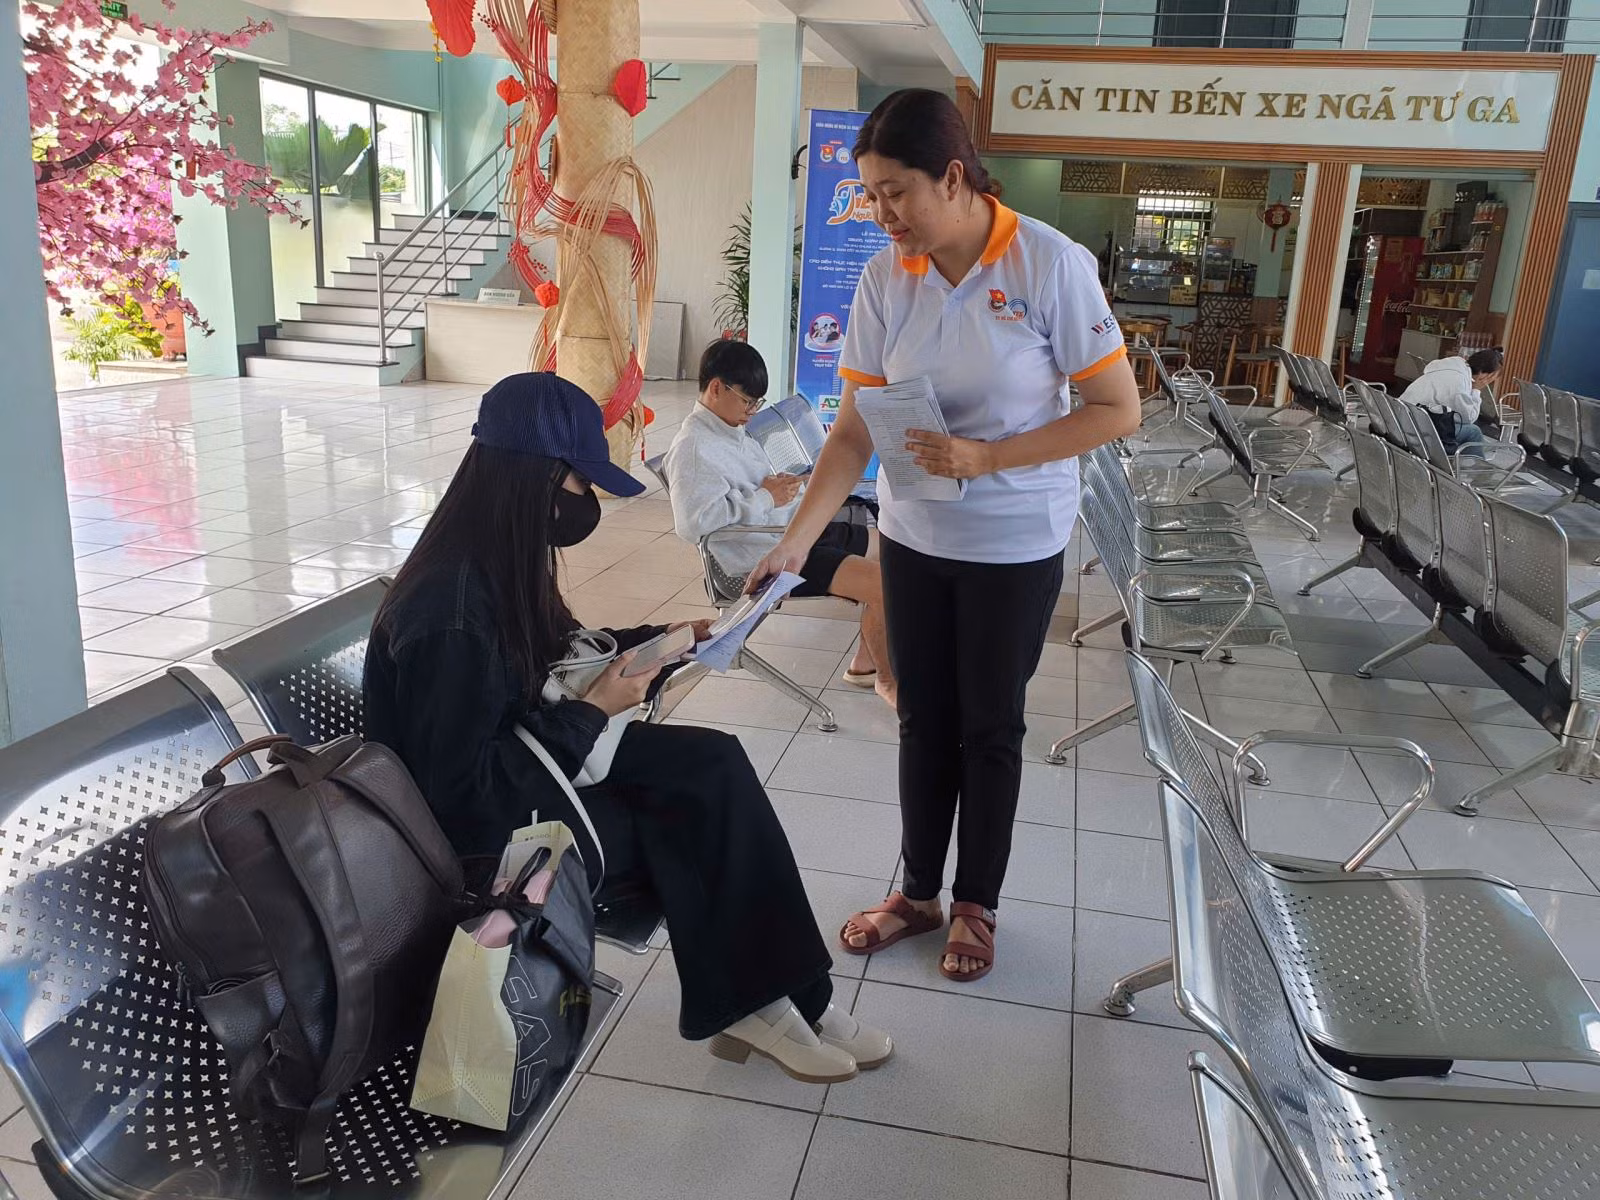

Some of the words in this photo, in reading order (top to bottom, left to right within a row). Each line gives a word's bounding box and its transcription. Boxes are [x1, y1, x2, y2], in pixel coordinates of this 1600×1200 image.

[1010, 79, 1085, 111] CĂN
[1095, 87, 1160, 114] TIN
[1169, 77, 1247, 117] BẾN
[1255, 92, 1308, 118] XE
[1315, 86, 1397, 121] NGÃ
[1405, 90, 1464, 122] TƯ
[1467, 95, 1521, 124] GA
